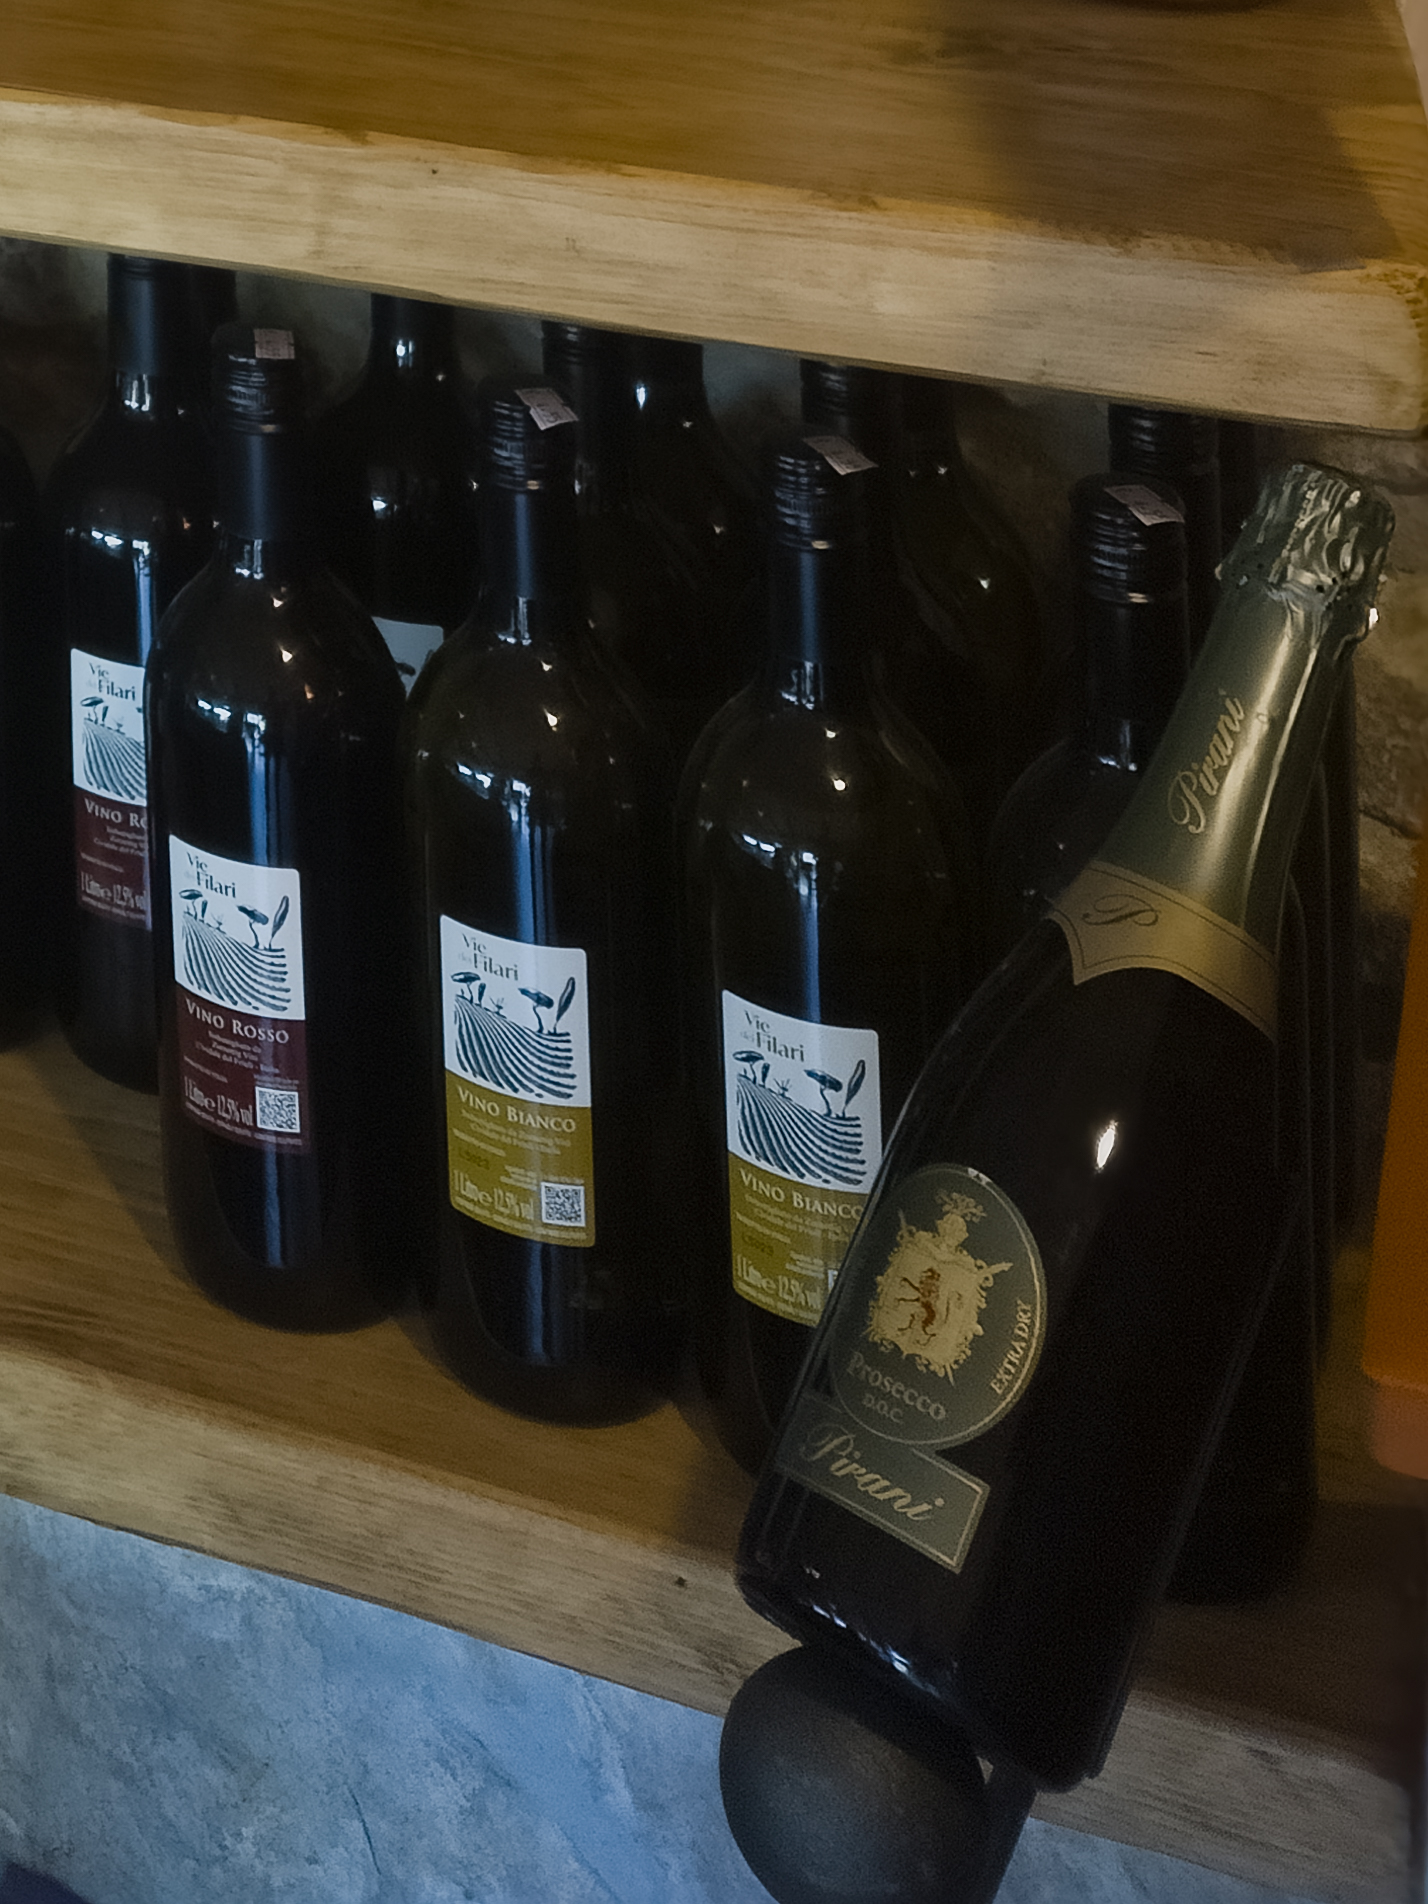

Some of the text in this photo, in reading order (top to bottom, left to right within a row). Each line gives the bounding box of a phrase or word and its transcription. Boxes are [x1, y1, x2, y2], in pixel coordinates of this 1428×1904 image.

[1166, 688, 1245, 834] Pirani
[230, 1014, 290, 1047] ROSSO
[506, 1103, 577, 1134] BIANCO
[790, 1188, 864, 1223] BIANCO
[989, 1297, 1035, 1396] EXTRA DRY
[847, 1349, 947, 1422] Prosecco
[809, 1428, 947, 1523] Pirani
